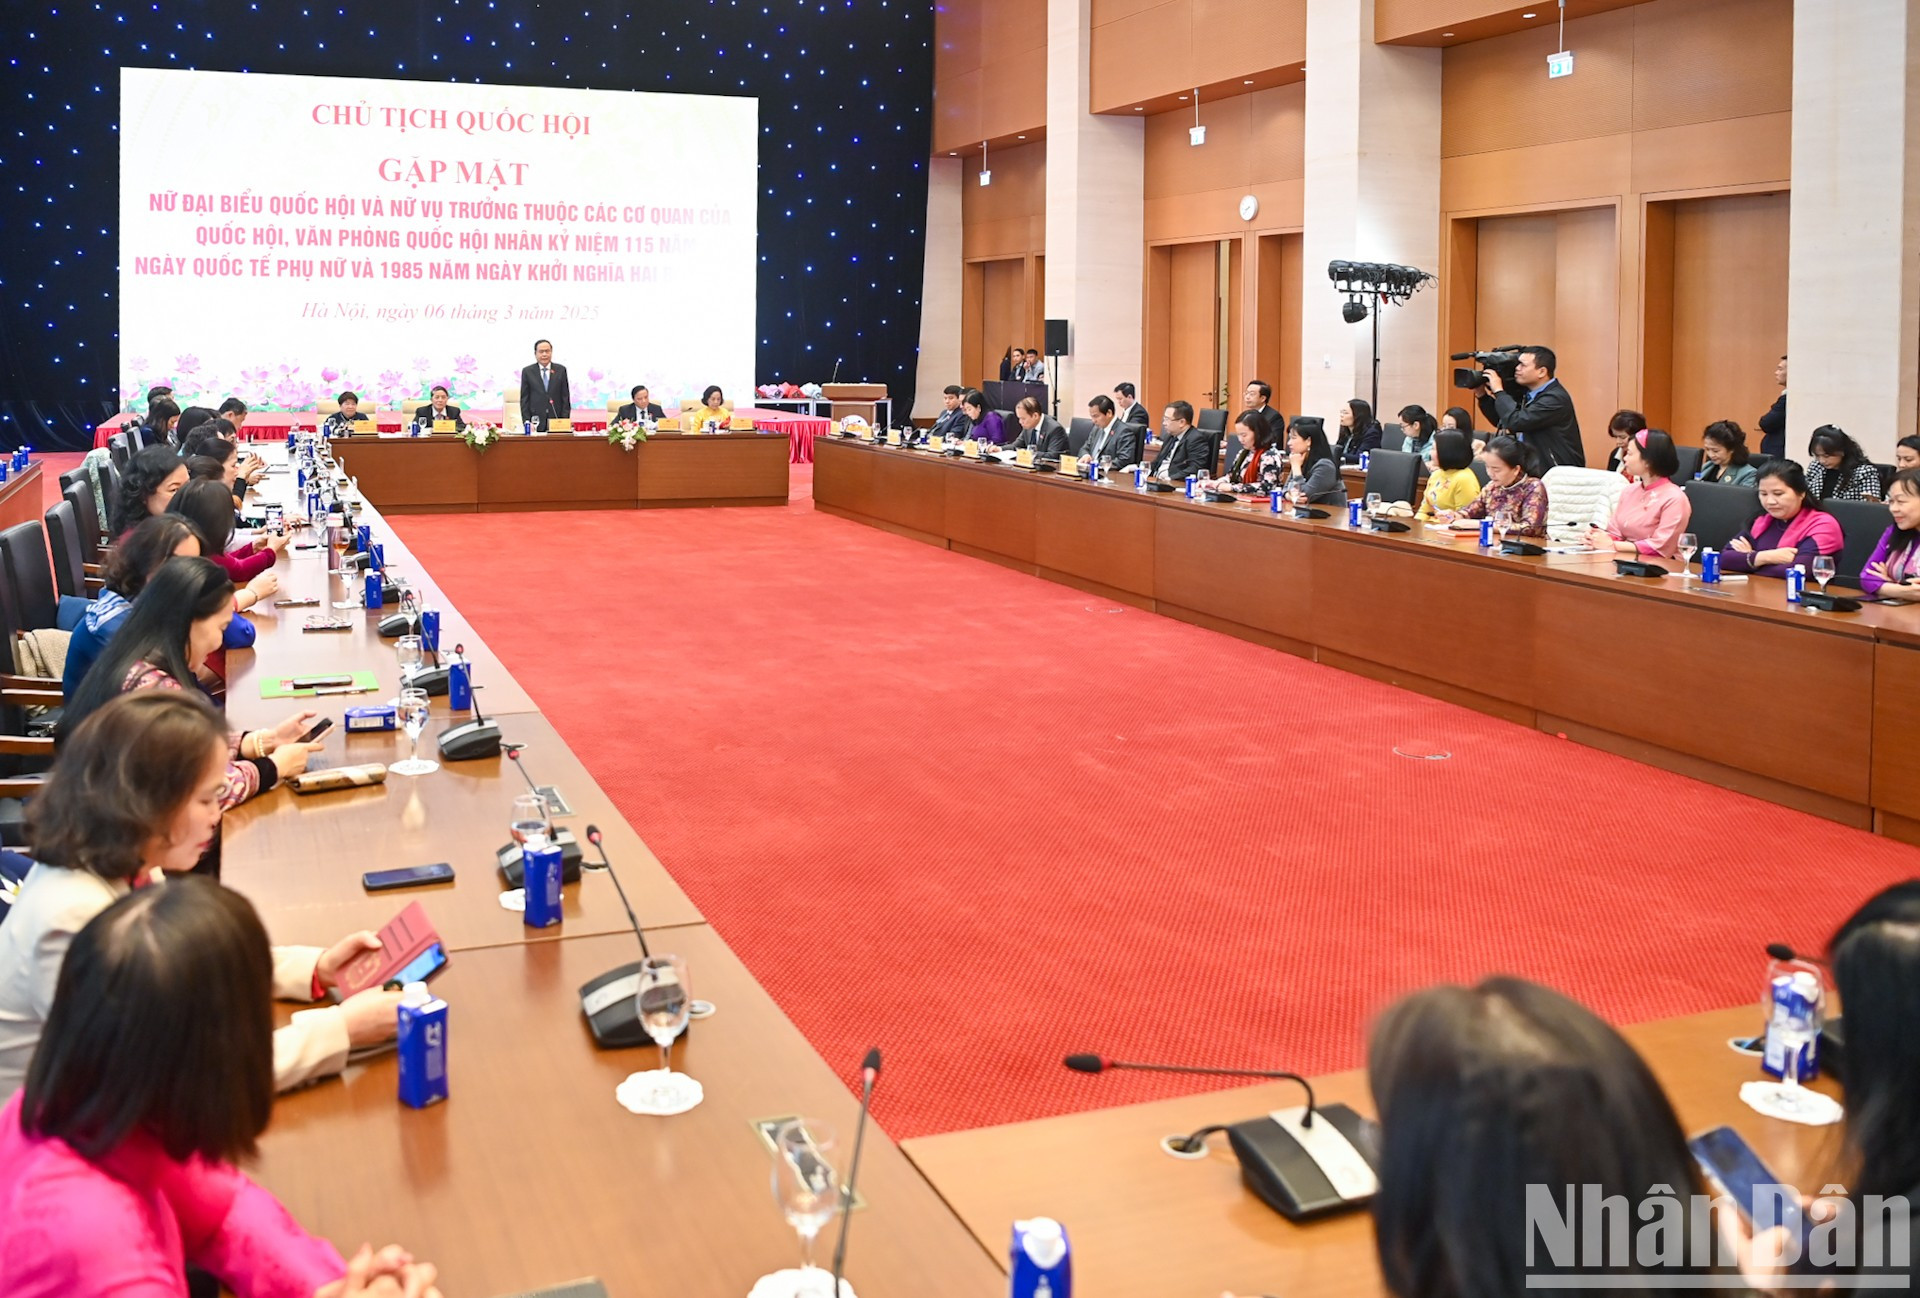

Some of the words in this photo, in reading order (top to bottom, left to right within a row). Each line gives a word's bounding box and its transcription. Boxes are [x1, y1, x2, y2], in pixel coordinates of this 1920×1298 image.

[312, 100, 372, 127] CHỦ
[380, 107, 448, 134] TỊCH
[456, 106, 535, 136] QUỐC
[543, 112, 590, 140] HỘI
[378, 155, 448, 190] GẶP
[455, 157, 529, 191] MẶT
[149, 190, 179, 213] NỮ
[182, 194, 214, 217] ĐẠI
[220, 189, 263, 214] BIỂU
[270, 192, 319, 217] QUỐC
[325, 194, 356, 219] HỘI
[361, 196, 385, 216] VÀ
[390, 196, 418, 217] NỮ
[420, 200, 444, 222] VỤ
[449, 196, 519, 220] TRƯỞNG
[524, 201, 579, 225] THUỘC
[584, 201, 617, 223] CÁC
[623, 205, 645, 223] CƠ
[651, 207, 694, 226] QUAN
[699, 203, 732, 225] CỦA
[196, 220, 247, 246] QUỐC
[253, 222, 289, 249] HỘI,
[295, 225, 333, 246] VĂN
[338, 226, 401, 248] PHÒNG
[406, 225, 454, 250] QUỐC
[459, 227, 489, 252] HỘI
[493, 230, 543, 251] NHÂN
[548, 229, 571, 251] KỶ
[576, 231, 618, 255] NIỆM
[625, 237, 654, 253] 115
[135, 254, 187, 276] NGÀY
[192, 252, 244, 278] QUỐC
[249, 252, 271, 277] TẾ
[277, 259, 314, 282] PHỤ
[320, 257, 347, 278] NỮ
[352, 257, 376, 278] VÀ
[381, 261, 424, 279] 1985
[429, 260, 470, 280] NĂM
[475, 260, 523, 281] NGÀY
[528, 258, 568, 281] KHỞI
[574, 261, 625, 282] NGHĨA
[631, 265, 658, 282] HAI
[301, 302, 328, 319] Hà
[334, 302, 370, 322] Nội,
[377, 303, 418, 323] ngày
[423, 304, 446, 319] 06
[450, 304, 497, 324] tháng
[503, 305, 513, 320] 3
[518, 307, 553, 321] năm
